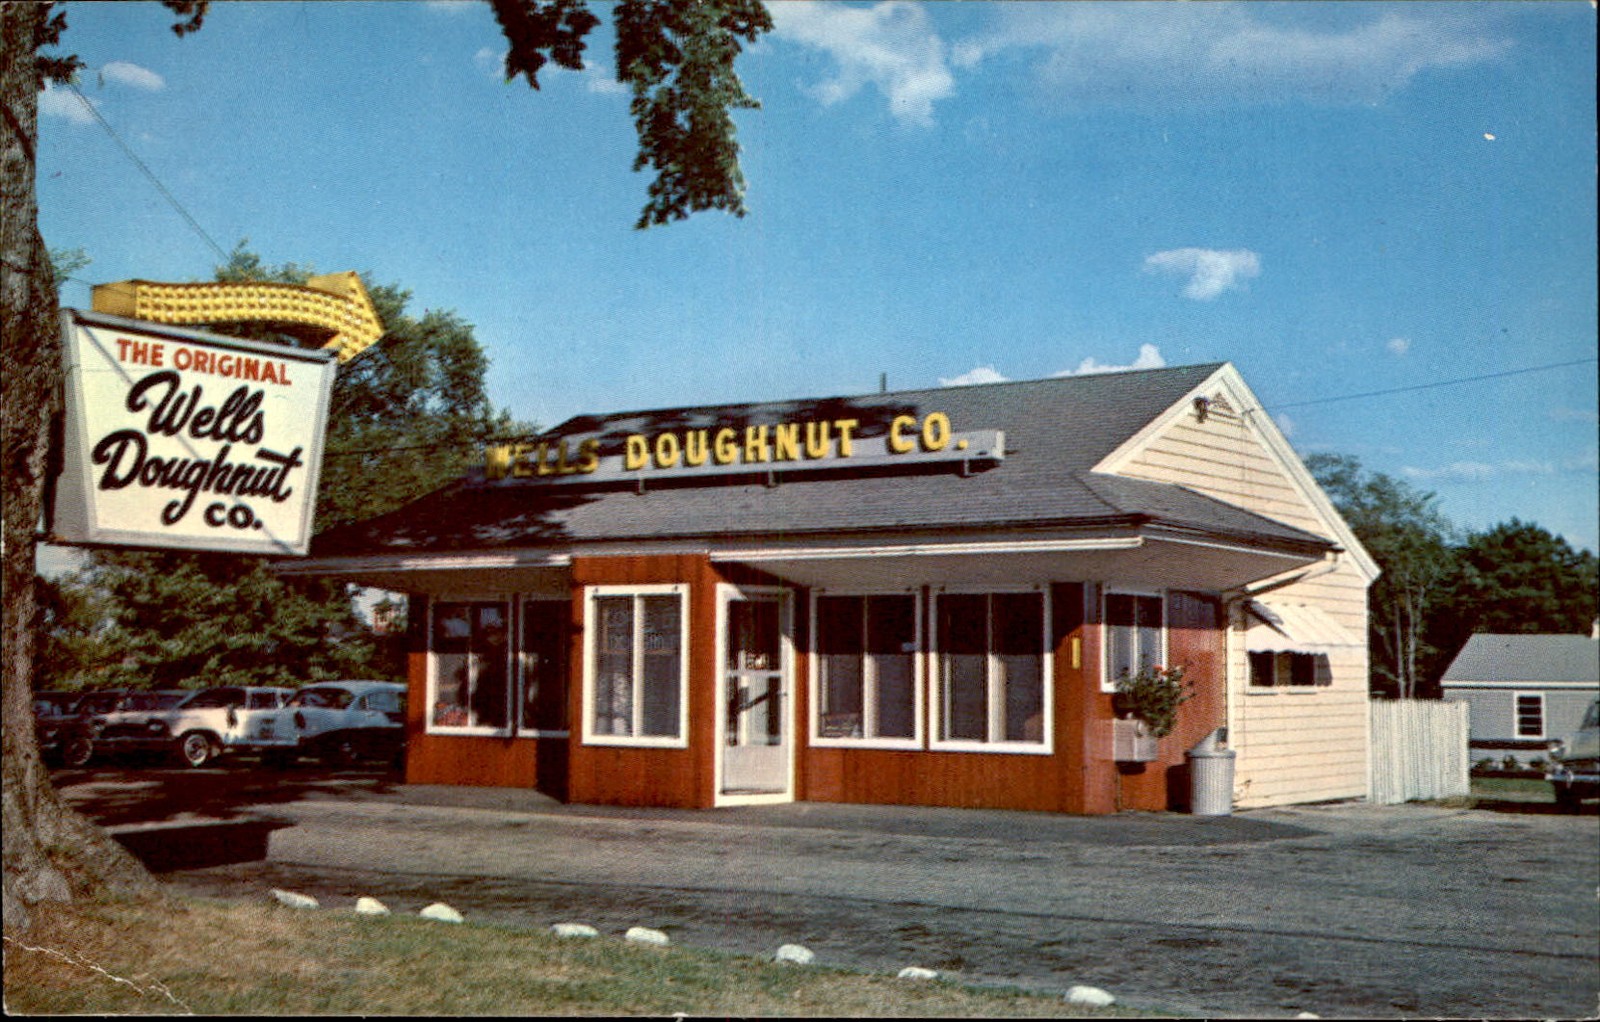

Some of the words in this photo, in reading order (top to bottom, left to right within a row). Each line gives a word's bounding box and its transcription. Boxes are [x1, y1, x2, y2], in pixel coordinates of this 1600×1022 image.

[116, 338, 164, 366] THE
[173, 348, 292, 386] ORIGINAL
[126, 371, 265, 444] Wells
[92, 428, 303, 525] Doughnut
[485, 438, 599, 478] WELLS
[625, 418, 858, 469] DOUGHNUT
[888, 412, 968, 453] CO.
